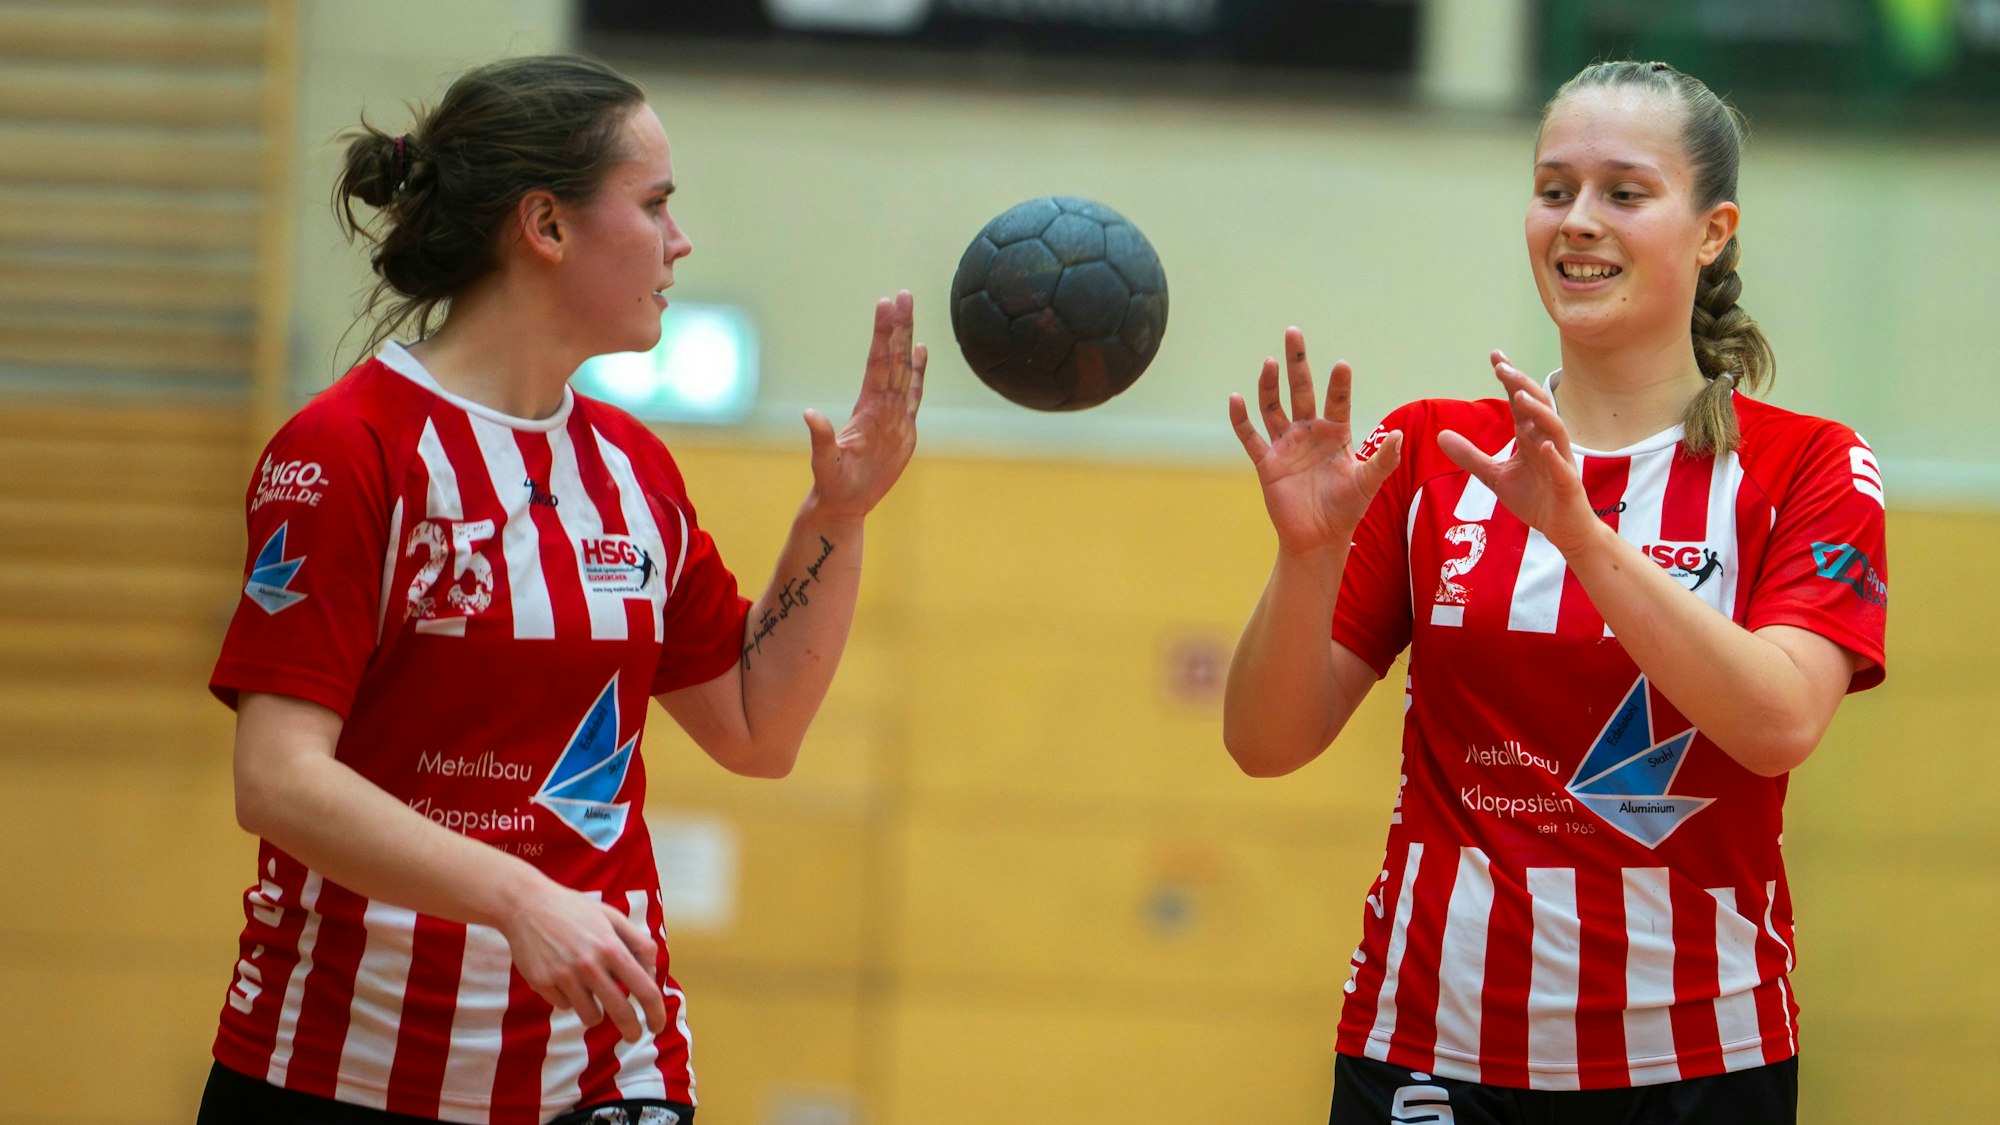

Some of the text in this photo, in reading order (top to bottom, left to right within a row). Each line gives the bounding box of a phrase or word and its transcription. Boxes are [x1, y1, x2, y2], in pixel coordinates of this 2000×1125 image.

[581, 538, 637, 566] HSG
[1435, 523, 1487, 604] 2
[403, 519, 495, 623] 25
[1606, 702, 1639, 747] Edelstahl
[417, 750, 532, 782] Metallbau
[1465, 740, 1559, 775] Metallbau
[1648, 748, 1674, 768] Stahl
[1461, 784, 1574, 818] Kloppstein
[1619, 801, 1675, 814] Aluminium
[1537, 822, 1596, 834] seit 1965
[516, 842, 544, 857] 1965
